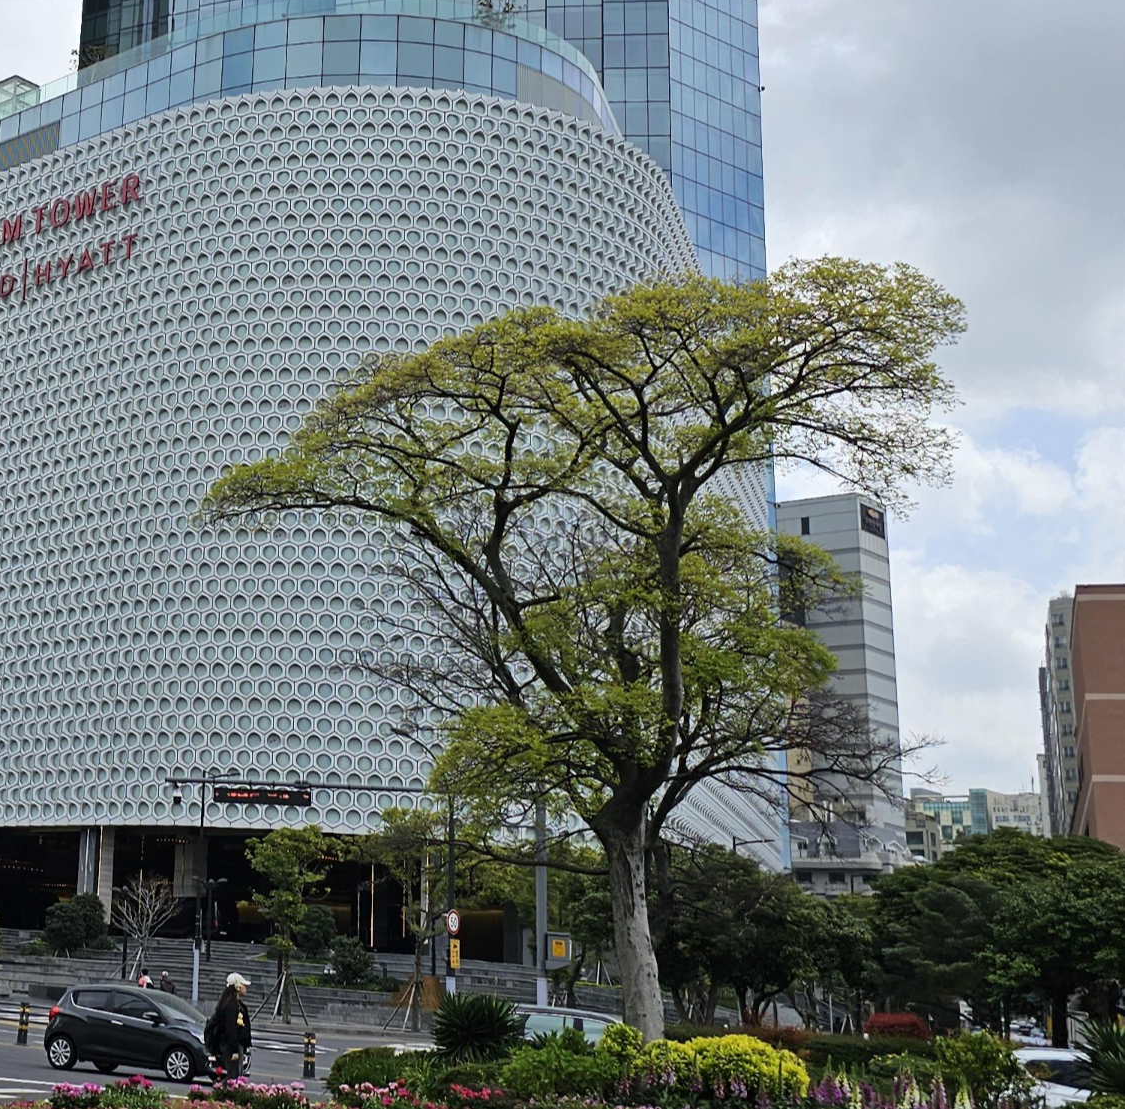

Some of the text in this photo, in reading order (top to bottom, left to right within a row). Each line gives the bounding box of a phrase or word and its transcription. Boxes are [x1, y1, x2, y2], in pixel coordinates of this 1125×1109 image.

[32, 174, 140, 234] TOWER
[34, 233, 138, 287] HYATT
[450, 916, 458, 928] 50
